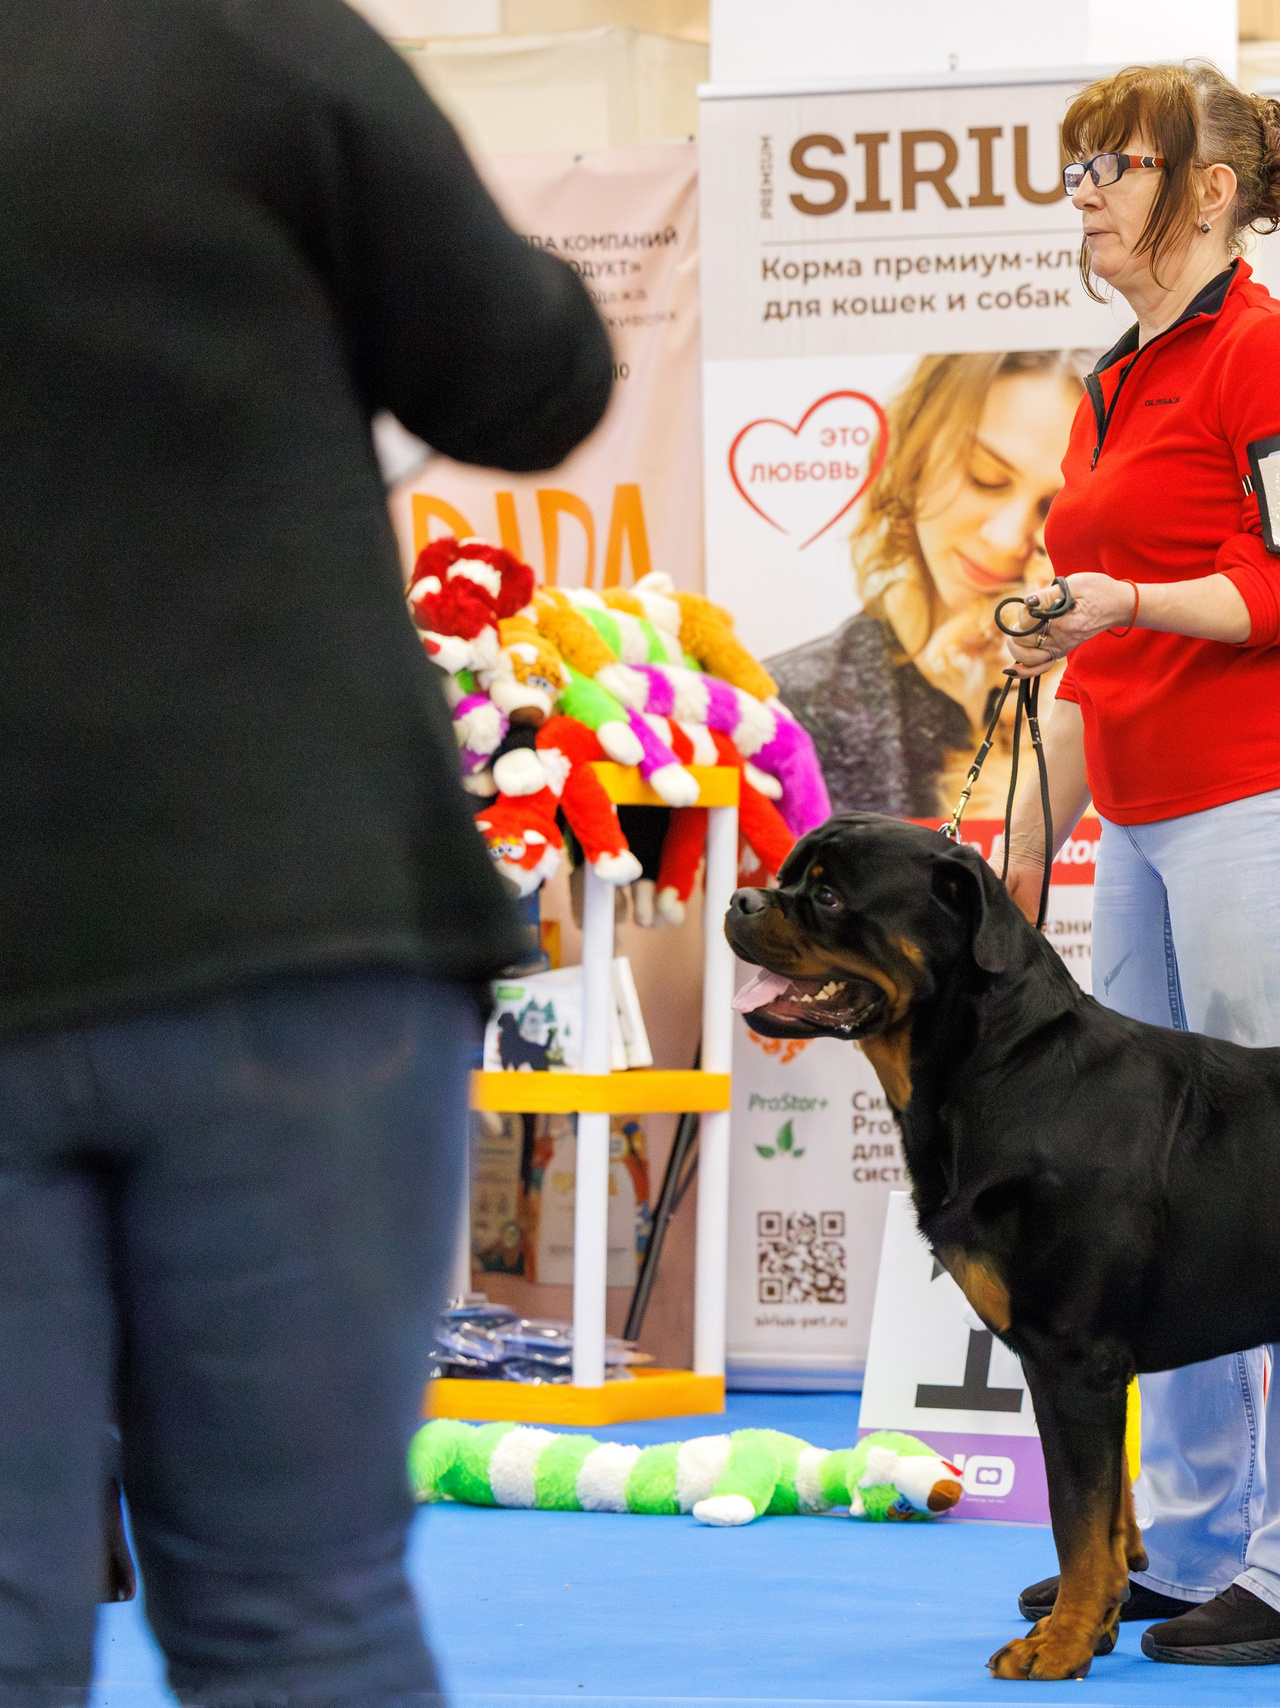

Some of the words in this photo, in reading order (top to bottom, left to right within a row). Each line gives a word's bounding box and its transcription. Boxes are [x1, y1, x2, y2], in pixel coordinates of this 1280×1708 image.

[788, 124, 1068, 218] SIRIU
[563, 225, 678, 252] КОМПАНИЙ
[762, 256, 863, 285] Корма
[763, 299, 822, 322] для
[832, 291, 937, 317] кошек
[947, 292, 967, 311] и
[976, 284, 1072, 310] собак
[820, 426, 870, 447] ЭТО
[749, 460, 860, 483] ЛЮБОВЬ
[852, 1143, 896, 1162] для
[852, 1167, 911, 1183] сист
